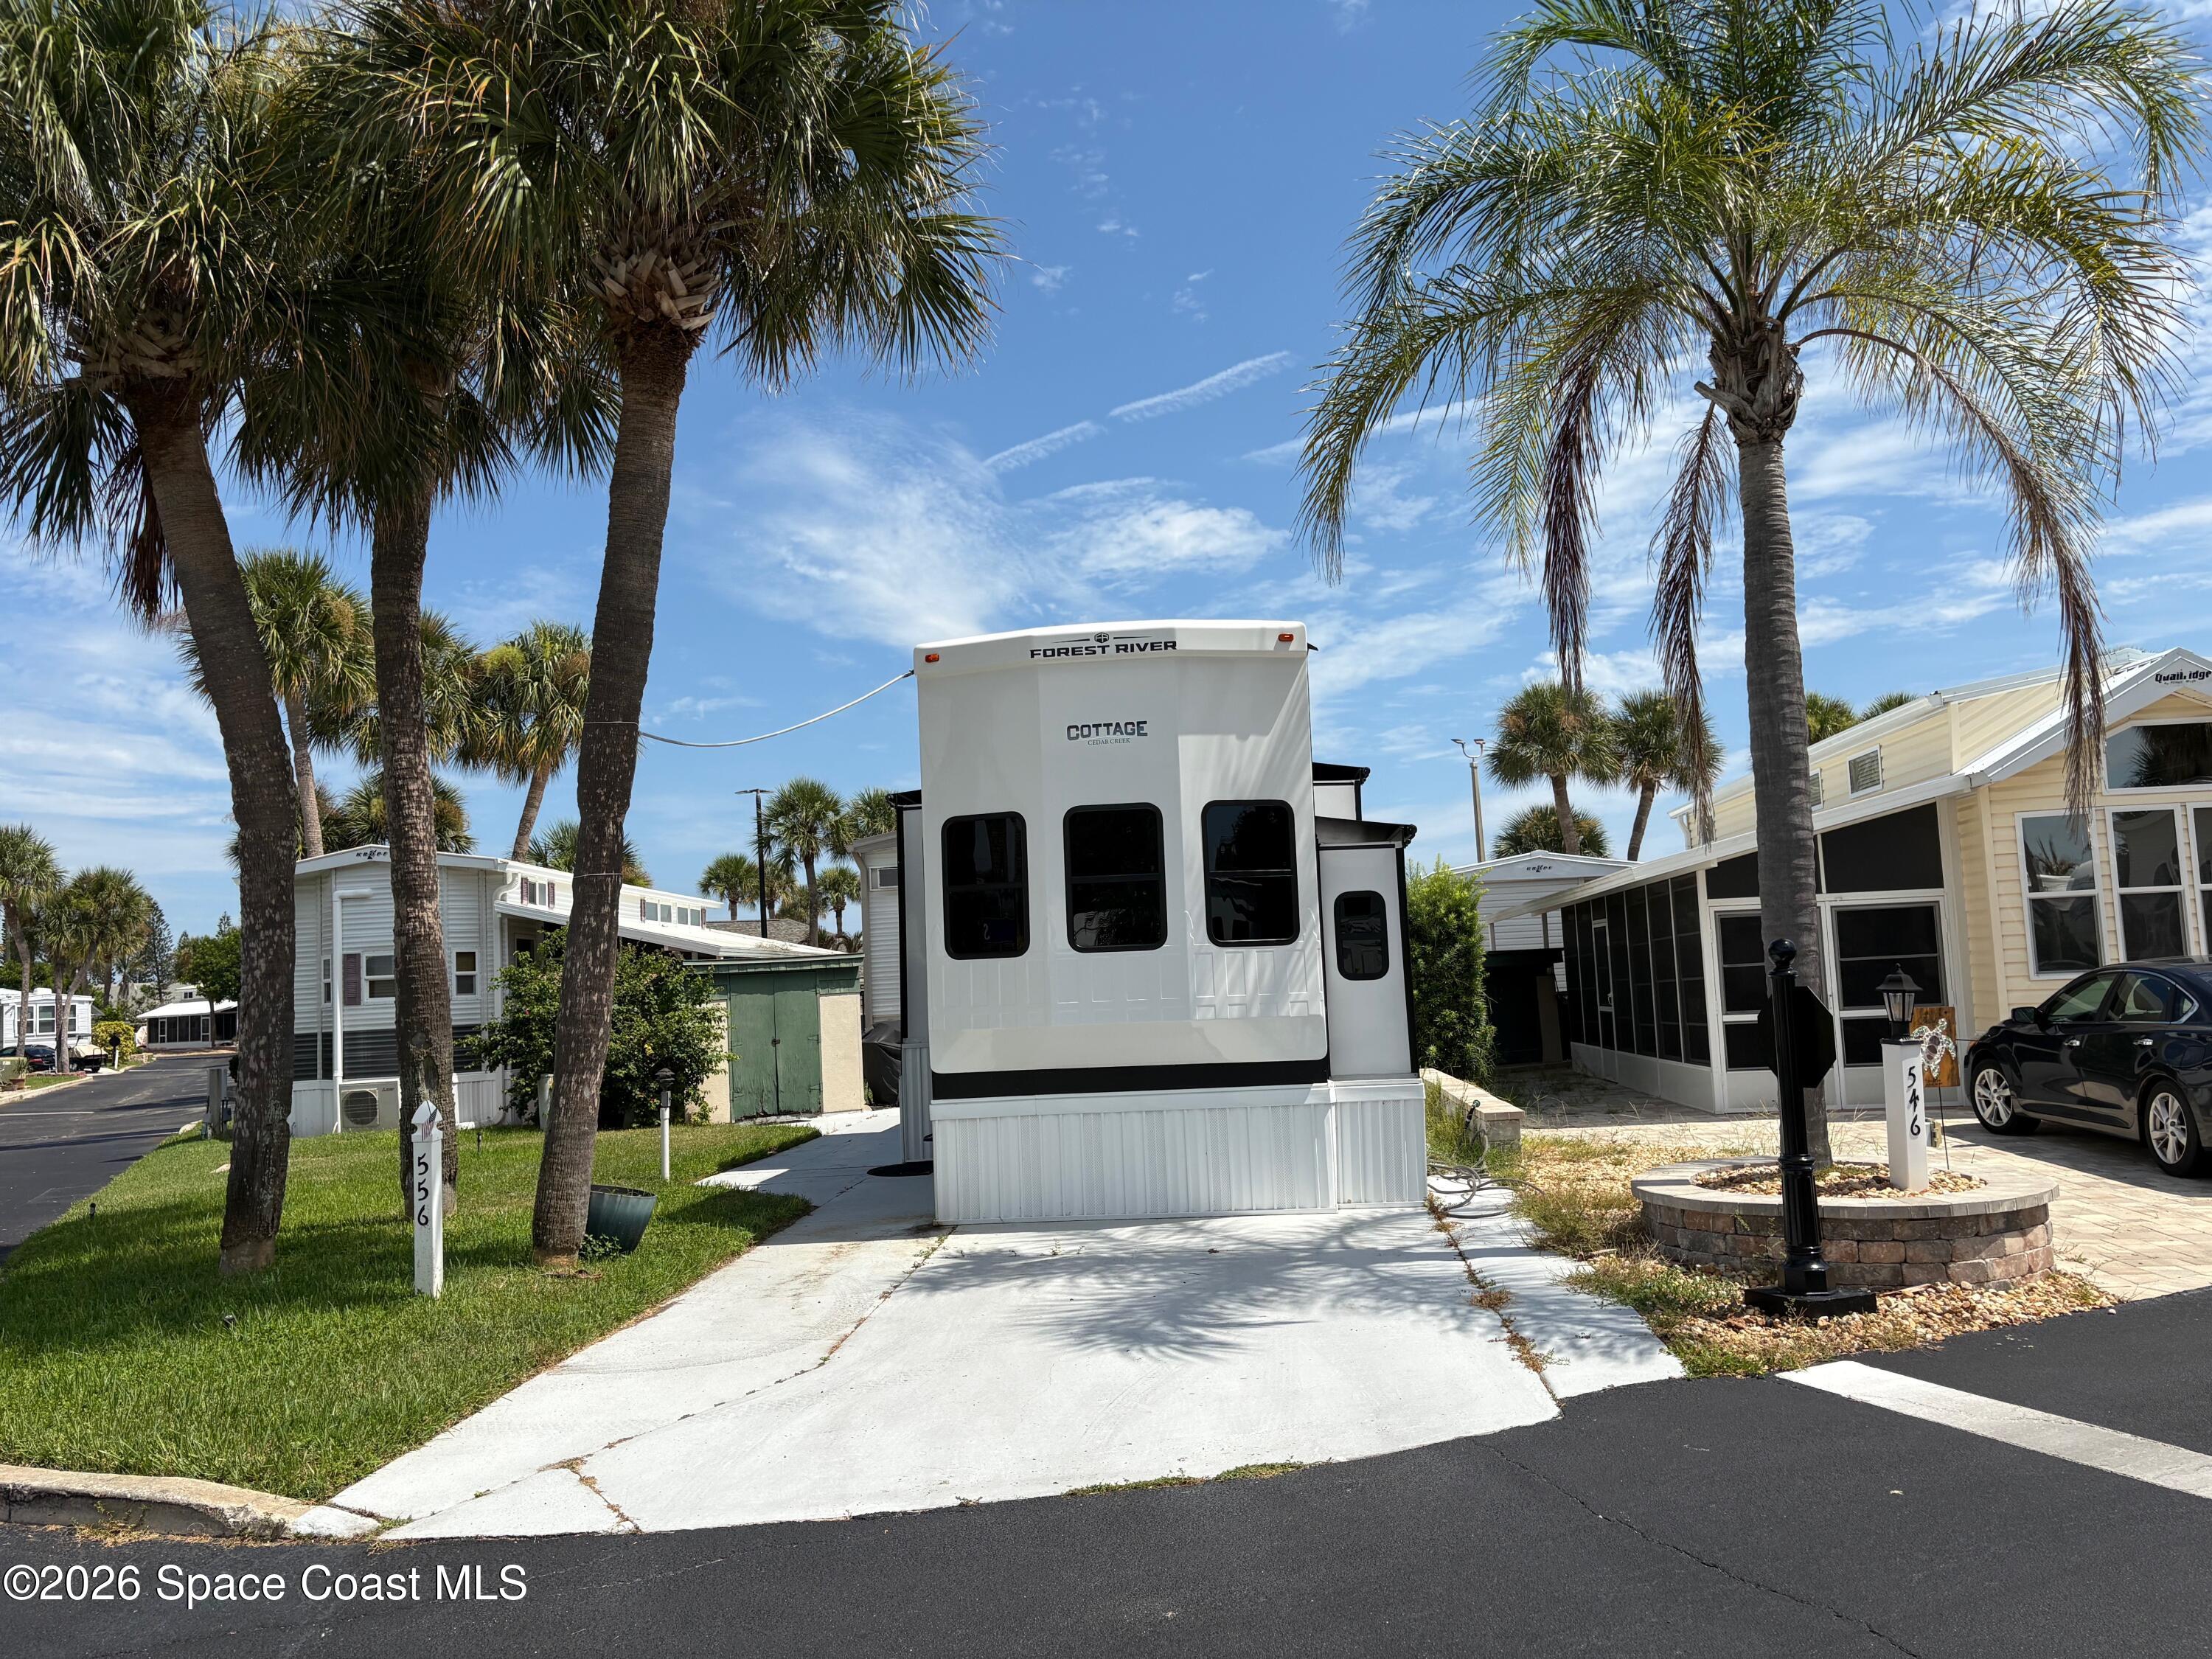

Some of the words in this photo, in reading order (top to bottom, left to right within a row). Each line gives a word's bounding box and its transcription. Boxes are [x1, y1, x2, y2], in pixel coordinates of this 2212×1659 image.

[1030, 645, 1110, 658] FOREST
[1115, 641, 1178, 653] RIVER
[1067, 720, 1148, 741] COTTAGE
[1907, 1065, 1921, 1136] 546
[417, 1152, 429, 1226] 556
